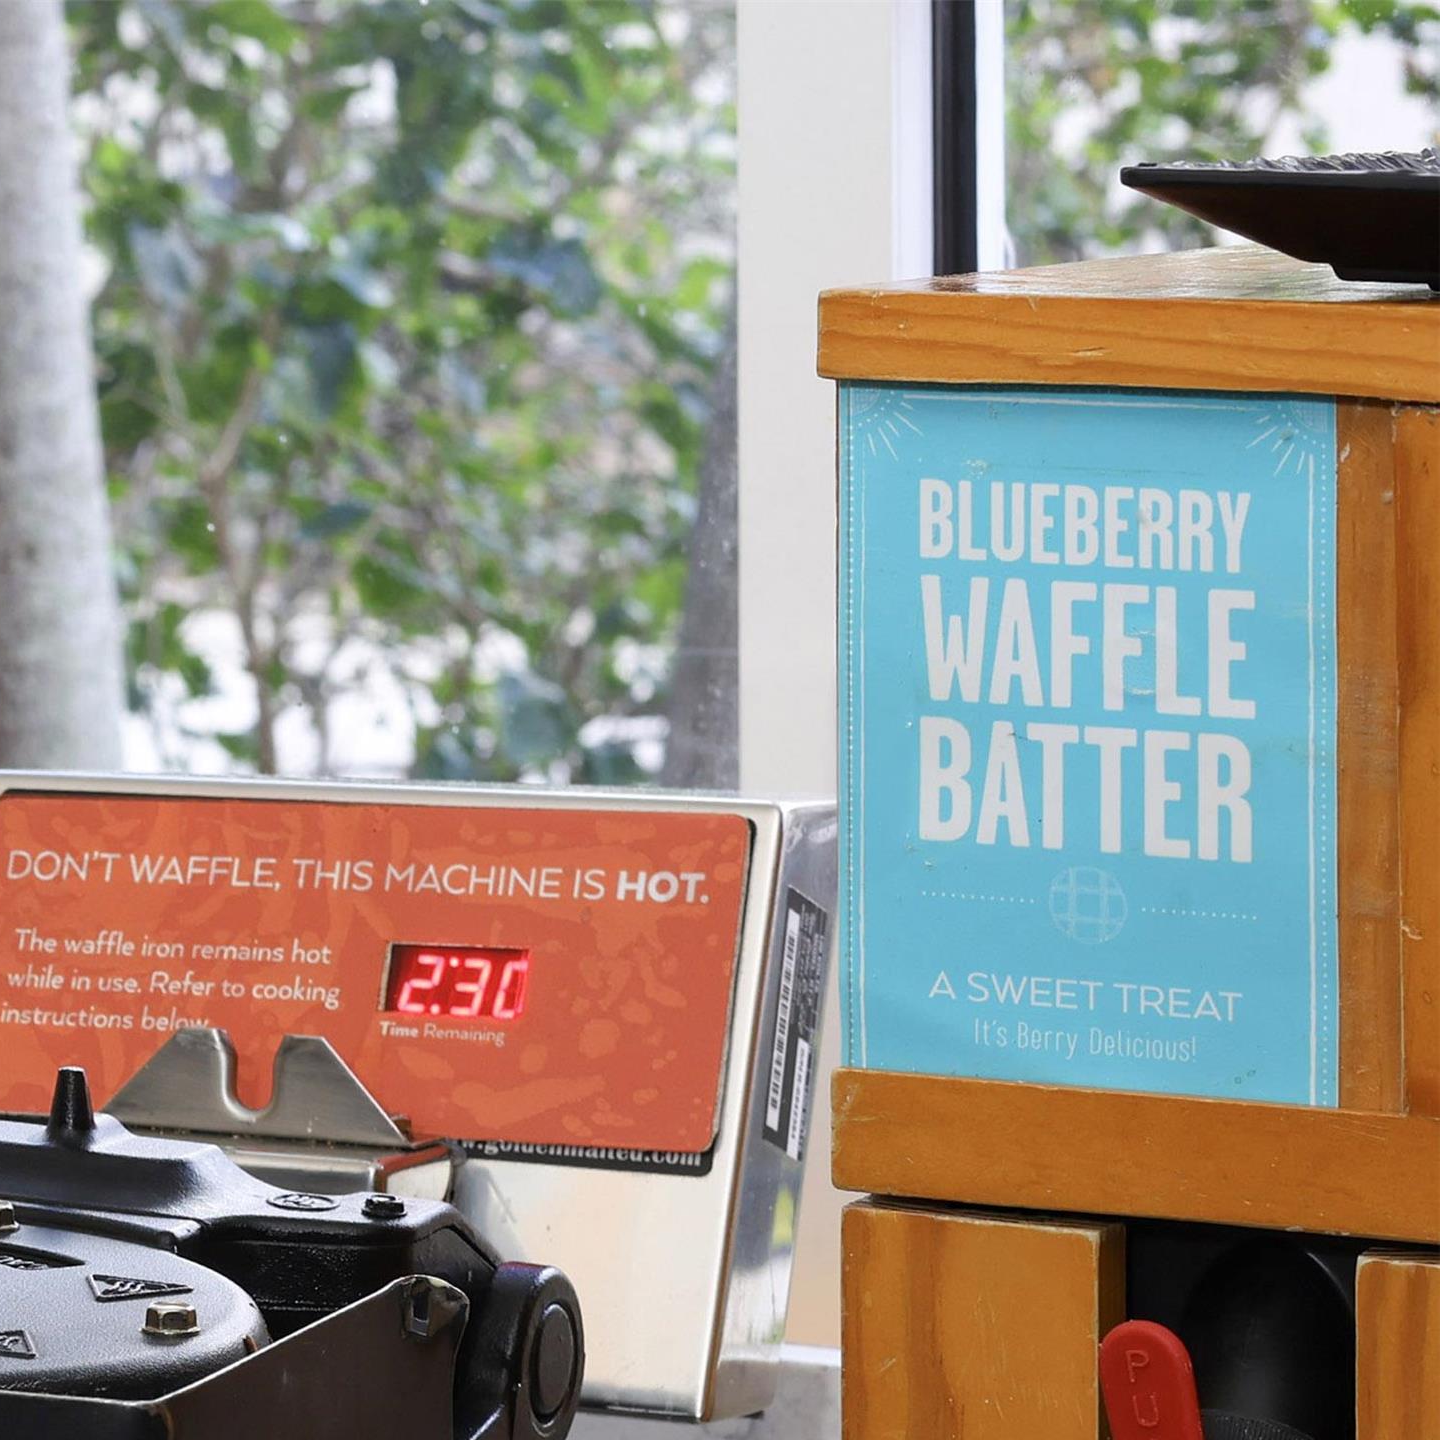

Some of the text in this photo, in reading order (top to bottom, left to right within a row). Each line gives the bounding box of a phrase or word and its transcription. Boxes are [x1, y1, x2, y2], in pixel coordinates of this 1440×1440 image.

[920, 478, 1251, 573] BLUEBERRY
[920, 574, 1256, 719] WAFFLE
[919, 715, 1253, 863] BATTER
[6, 849, 710, 904] DON'T WAFFLE, THIS MACHINE IS HOT.
[15, 927, 332, 964] The waffle iron remains hot
[8, 965, 341, 1011] while in use. Refer to cooking
[928, 970, 1243, 1023] A SWEET TREAT
[1, 1003, 133, 1029] instructions
[379, 1020, 505, 1047] Time Remaining
[974, 1017, 1198, 1063] It's Berry Delicious!
